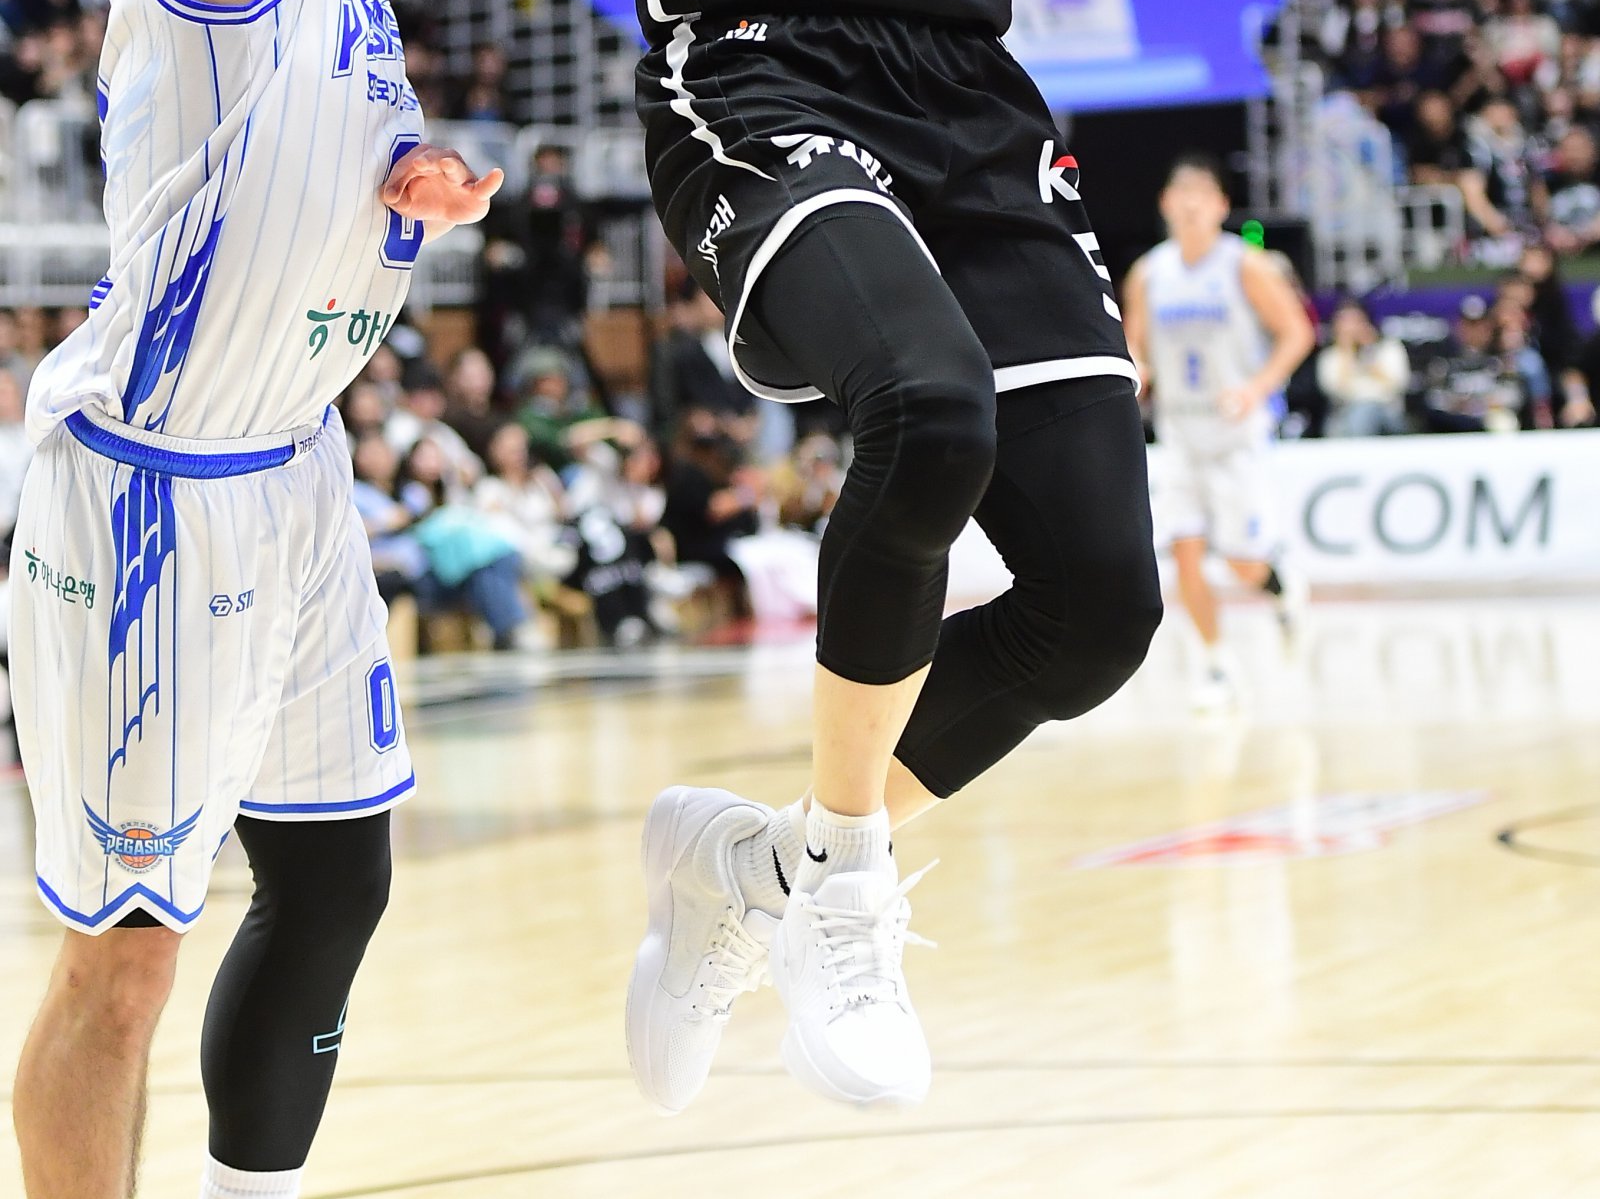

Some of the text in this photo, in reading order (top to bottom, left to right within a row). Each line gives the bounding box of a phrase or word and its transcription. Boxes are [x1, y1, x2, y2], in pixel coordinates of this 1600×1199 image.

[1038, 139, 1082, 204] k
[1302, 471, 1554, 555] COM
[41, 560, 96, 609] 하나은행
[364, 655, 401, 755] 0
[104, 832, 175, 856] PEGASUS
